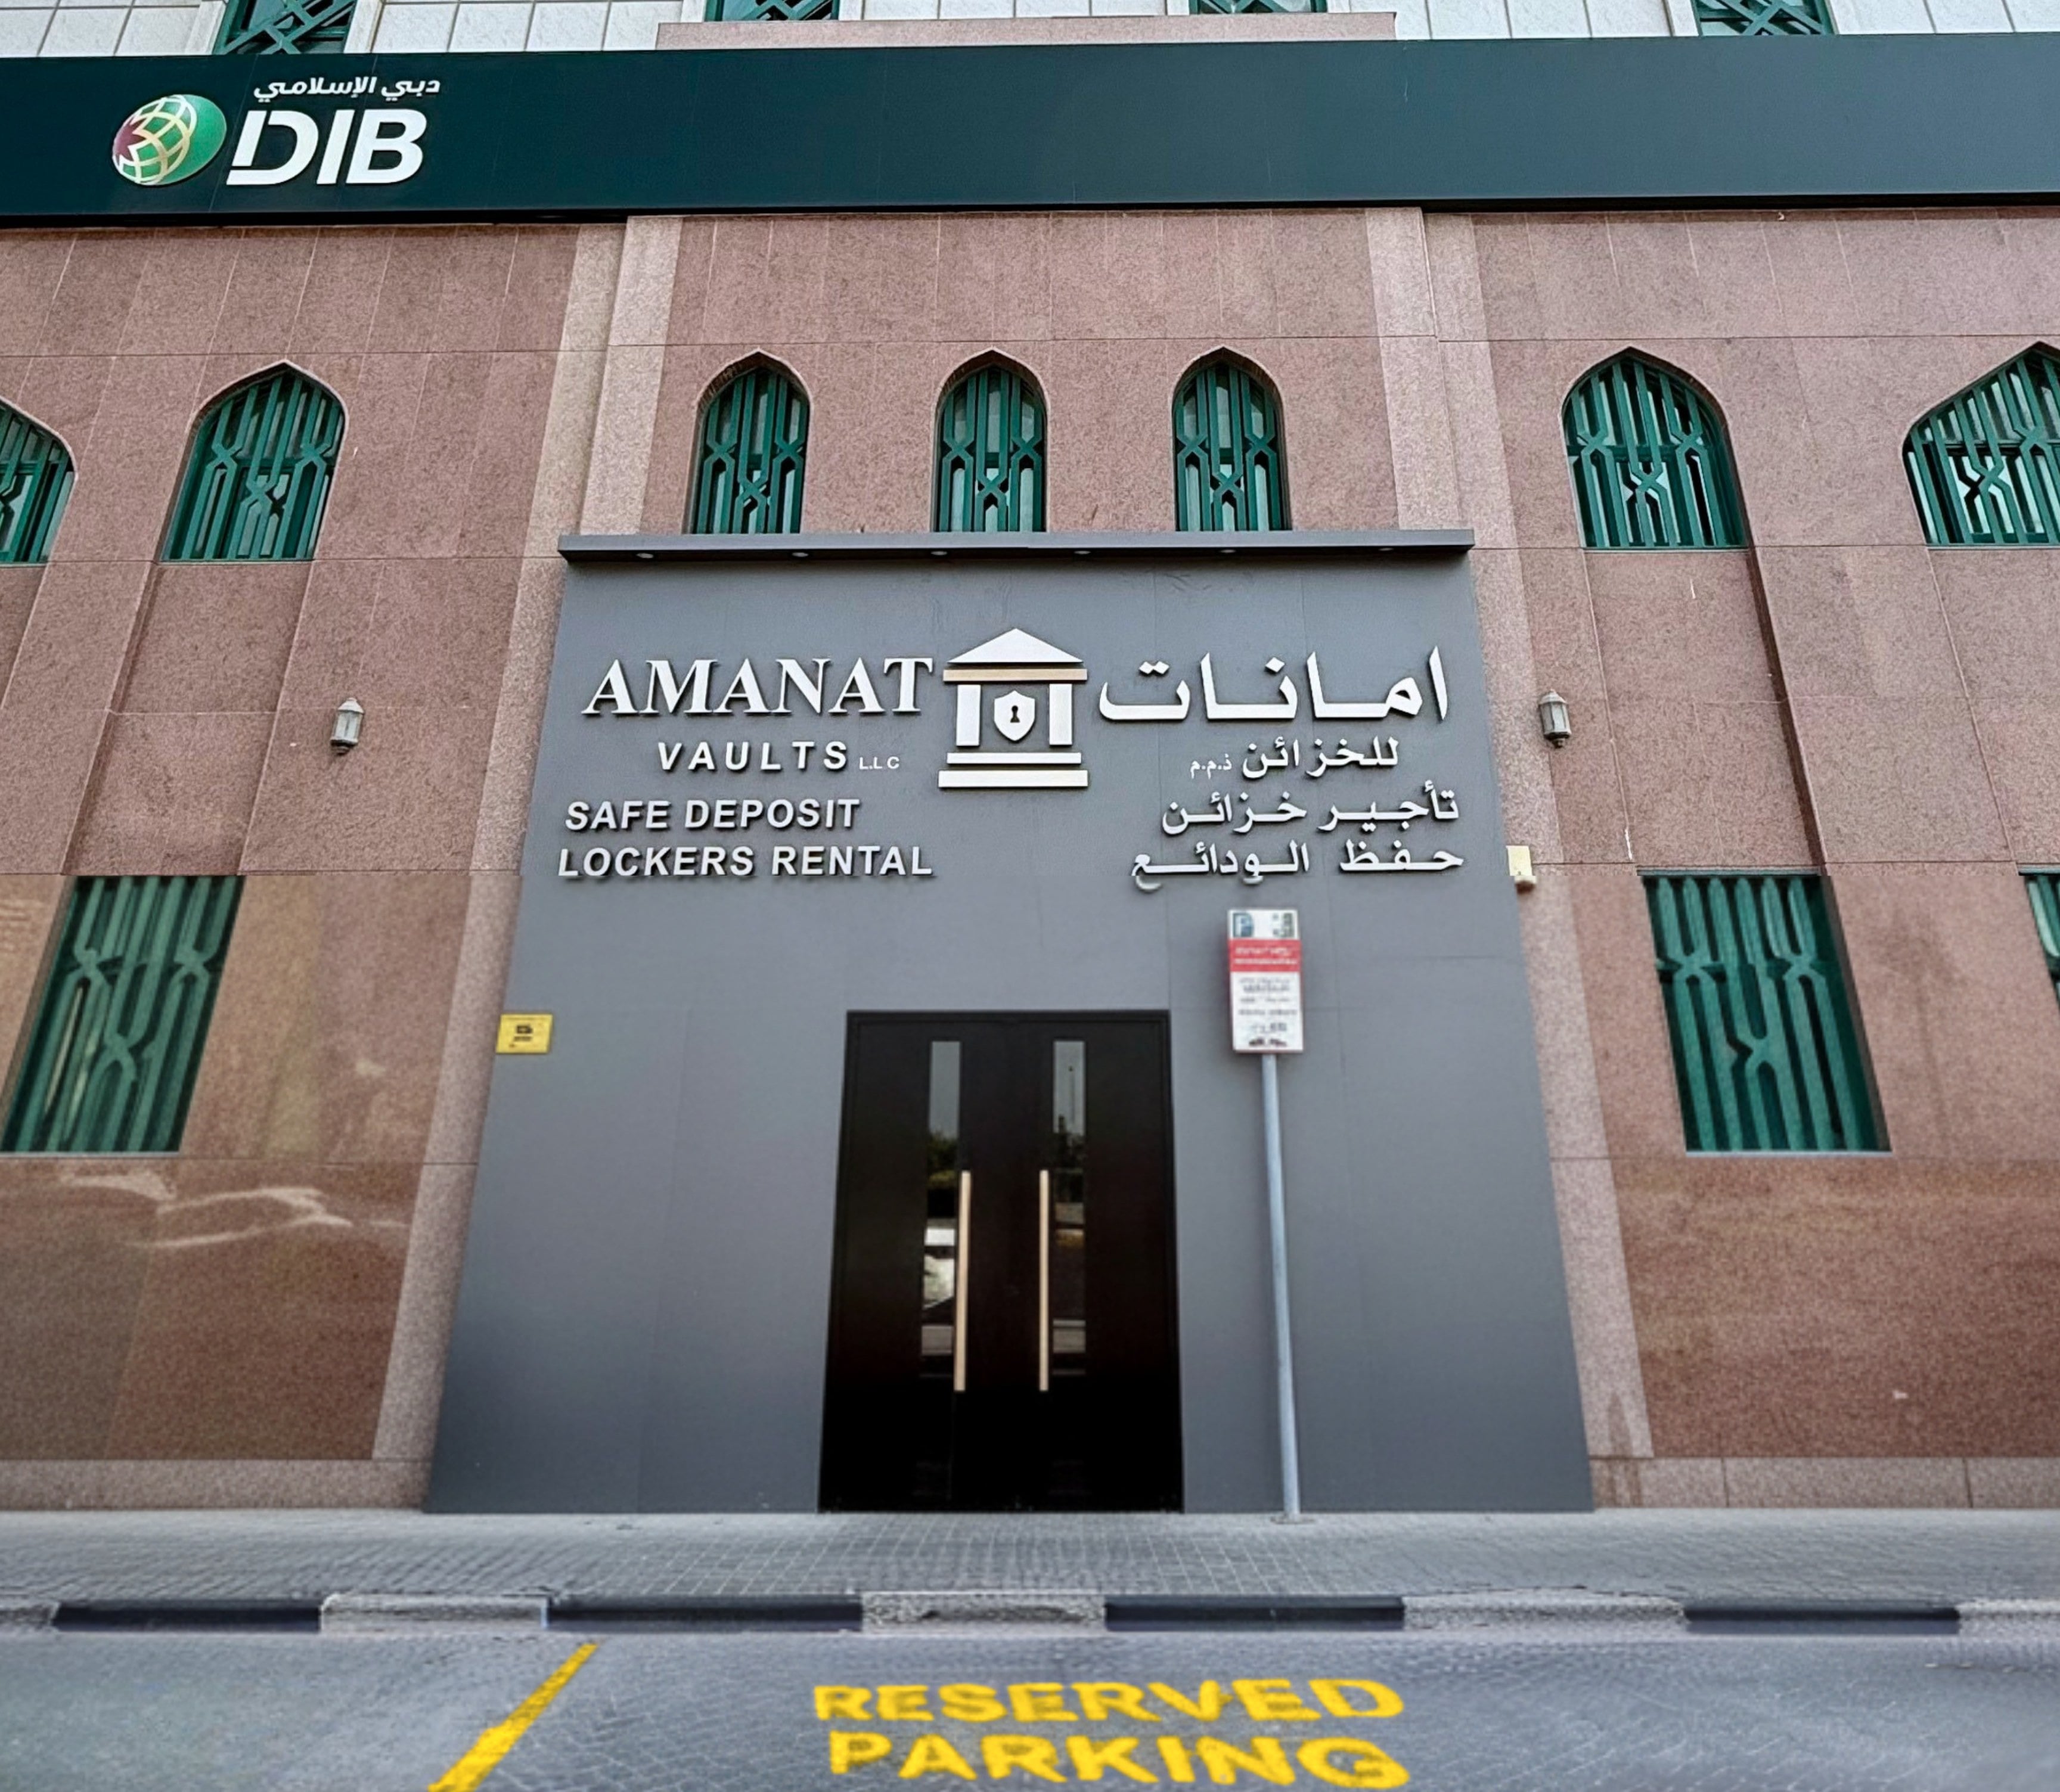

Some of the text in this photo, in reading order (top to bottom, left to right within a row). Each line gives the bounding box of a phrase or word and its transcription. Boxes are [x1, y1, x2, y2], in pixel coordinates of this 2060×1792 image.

[253, 76, 440, 102] دبي الإسلامي
[226, 108, 427, 185] DIB
[581, 657, 933, 715] AMANAT
[1099, 645, 1448, 720] امانات
[657, 740, 847, 771] VAULTS
[1243, 735, 1399, 778] للخزائن
[565, 799, 860, 830] SAFE DEPOSIT
[1162, 779, 1459, 834] تأجير خزائن
[558, 846, 932, 877] LOCKERS RENTAL
[1131, 838, 1465, 892] حفظ الودائع
[814, 1678, 1404, 1722] RESERVED
[829, 1731, 1410, 1789] PARKING
